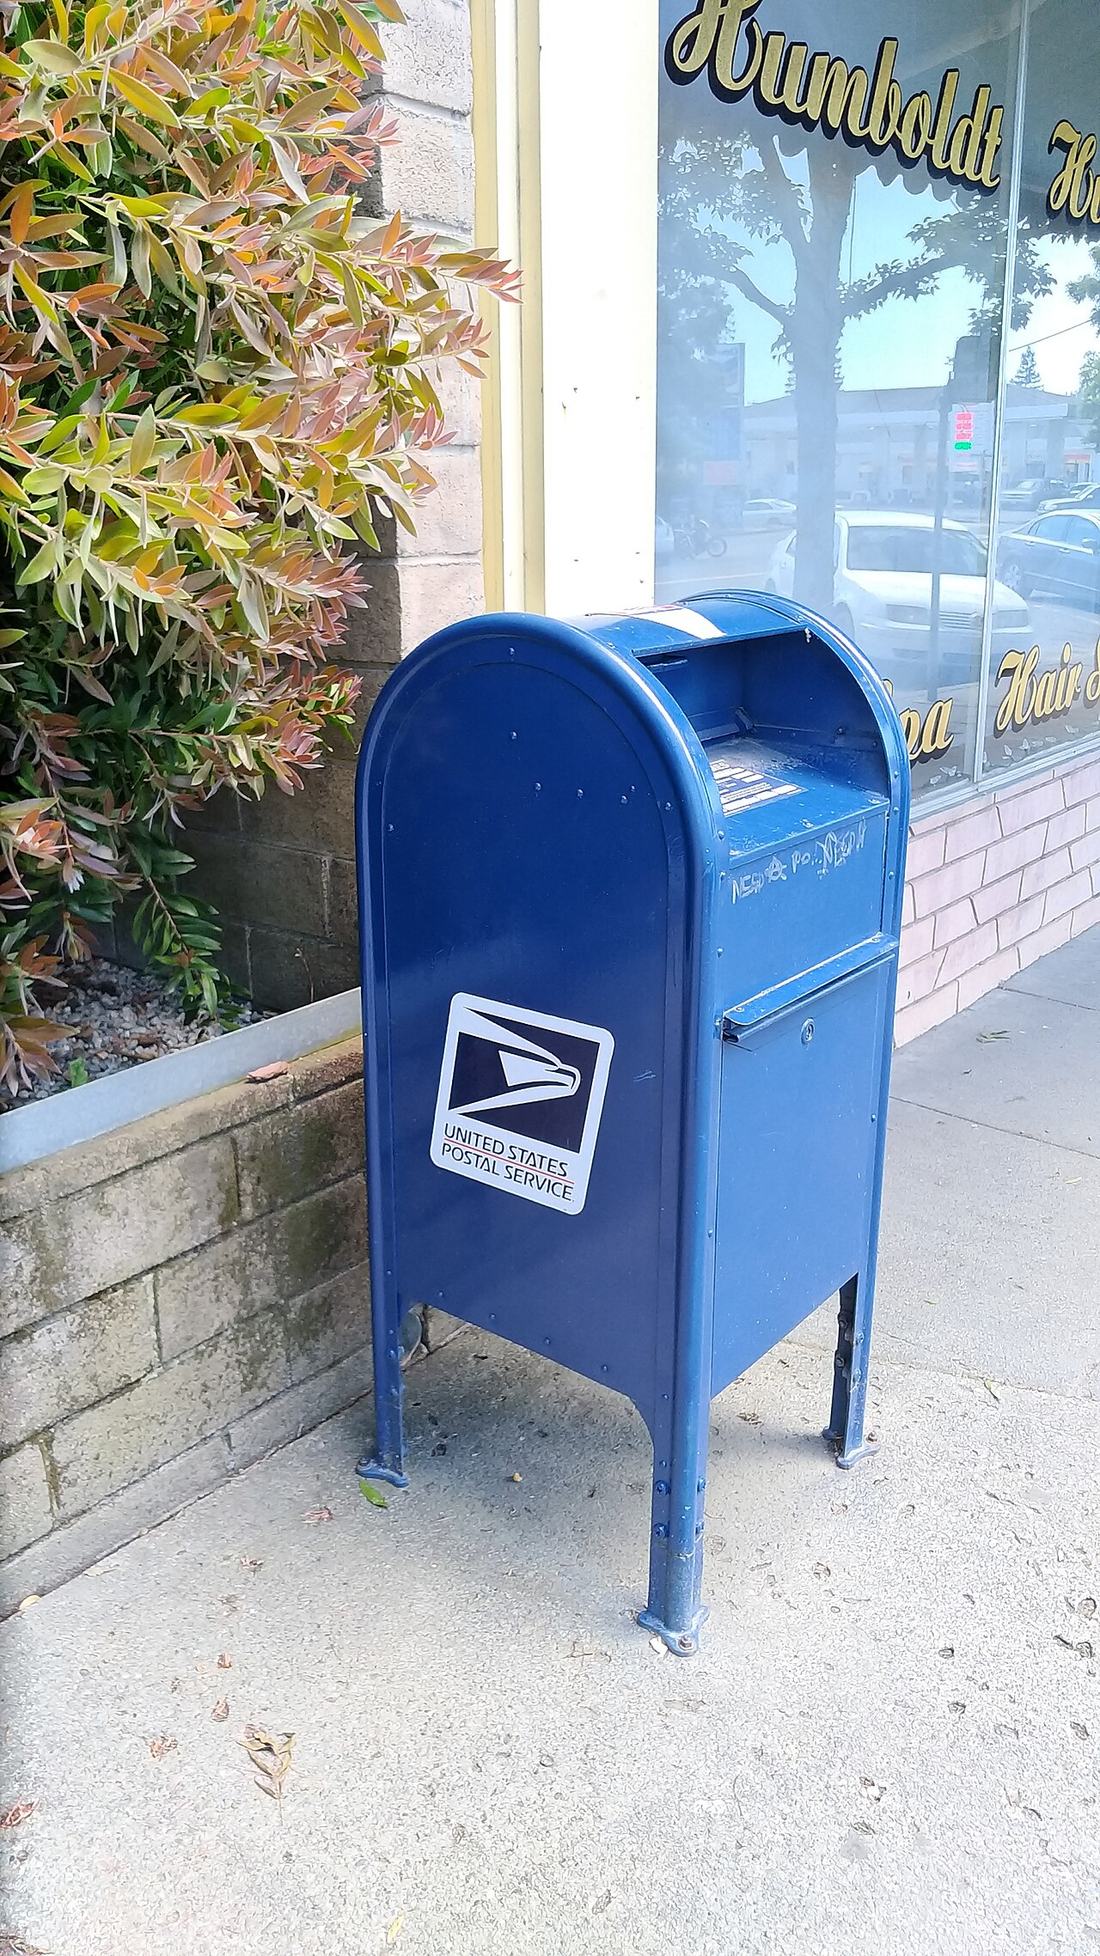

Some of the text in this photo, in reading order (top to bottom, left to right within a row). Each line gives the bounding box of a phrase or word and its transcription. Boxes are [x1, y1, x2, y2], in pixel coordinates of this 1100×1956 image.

[995, 642, 1083, 738] Hair
[442, 1143, 500, 1176] POSTAL
[444, 1123, 568, 1177] UNITED STATES
